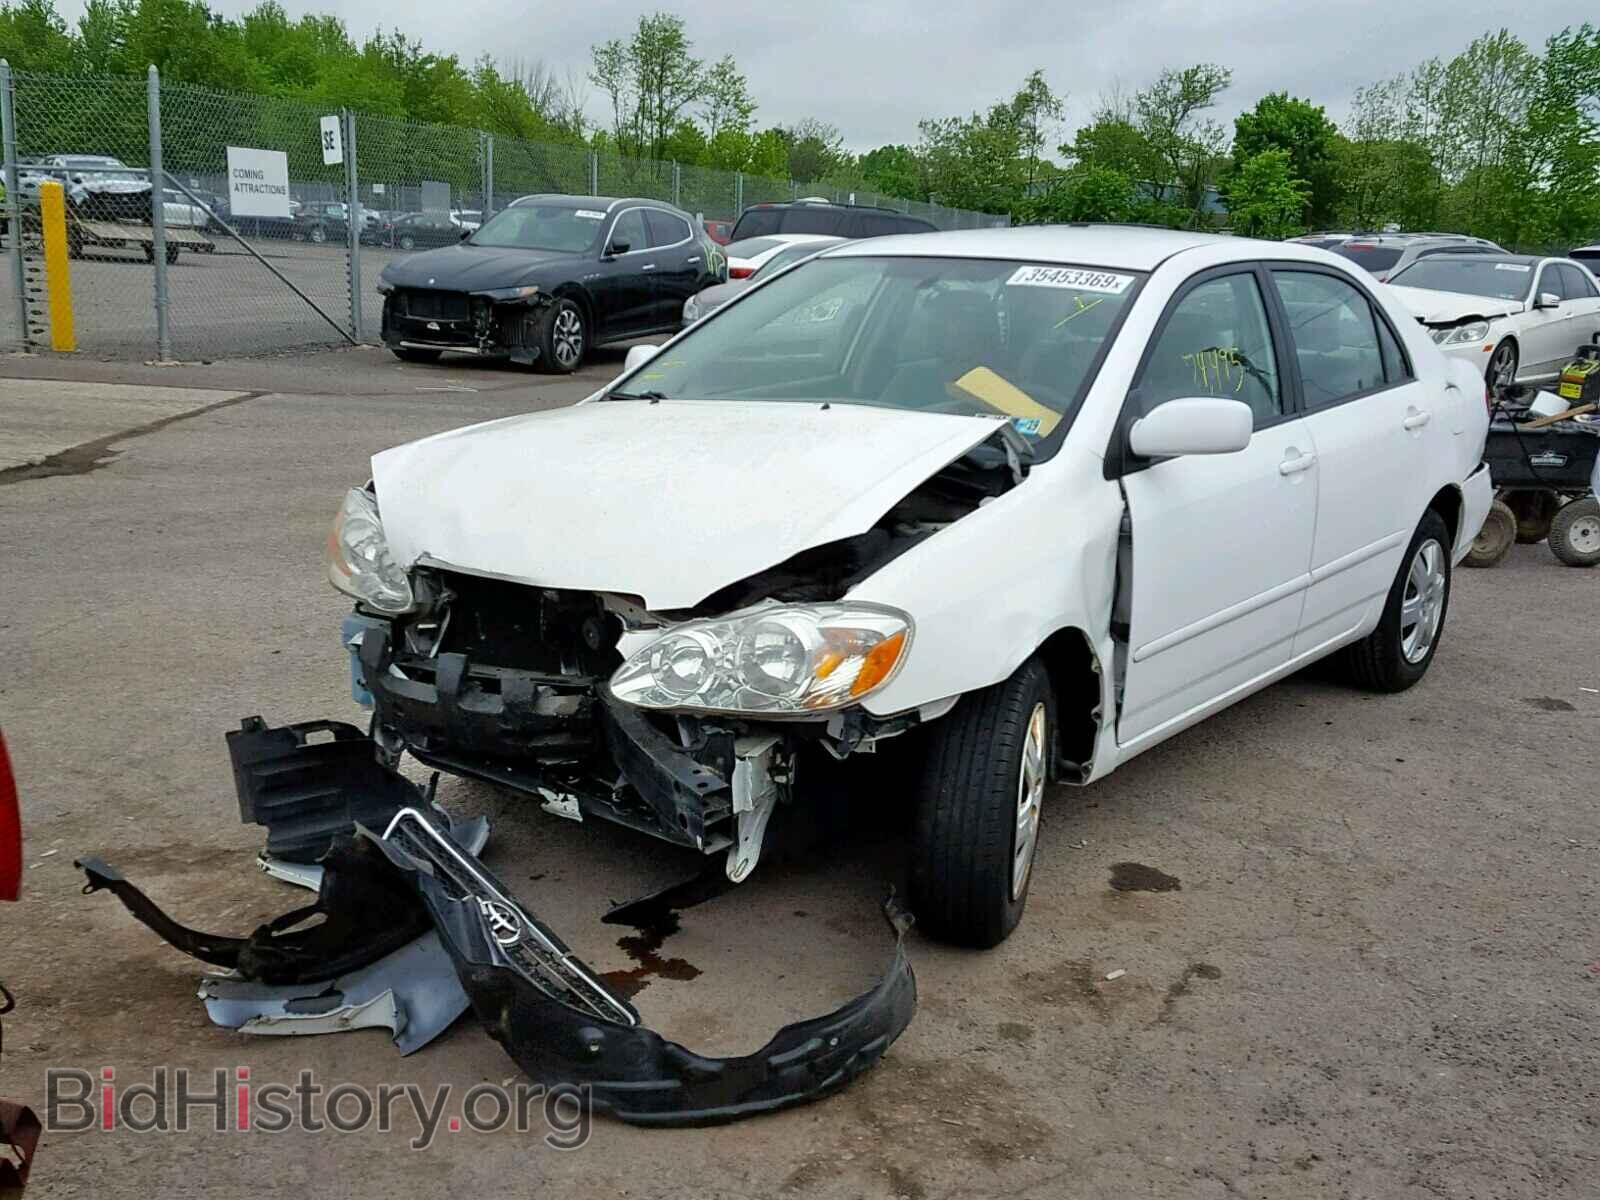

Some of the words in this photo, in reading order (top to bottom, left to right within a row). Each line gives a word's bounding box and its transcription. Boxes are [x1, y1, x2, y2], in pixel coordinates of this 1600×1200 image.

[324, 130, 335, 150] SE
[233, 168, 264, 179] COMING
[234, 183, 286, 195] ATTRACTIONS
